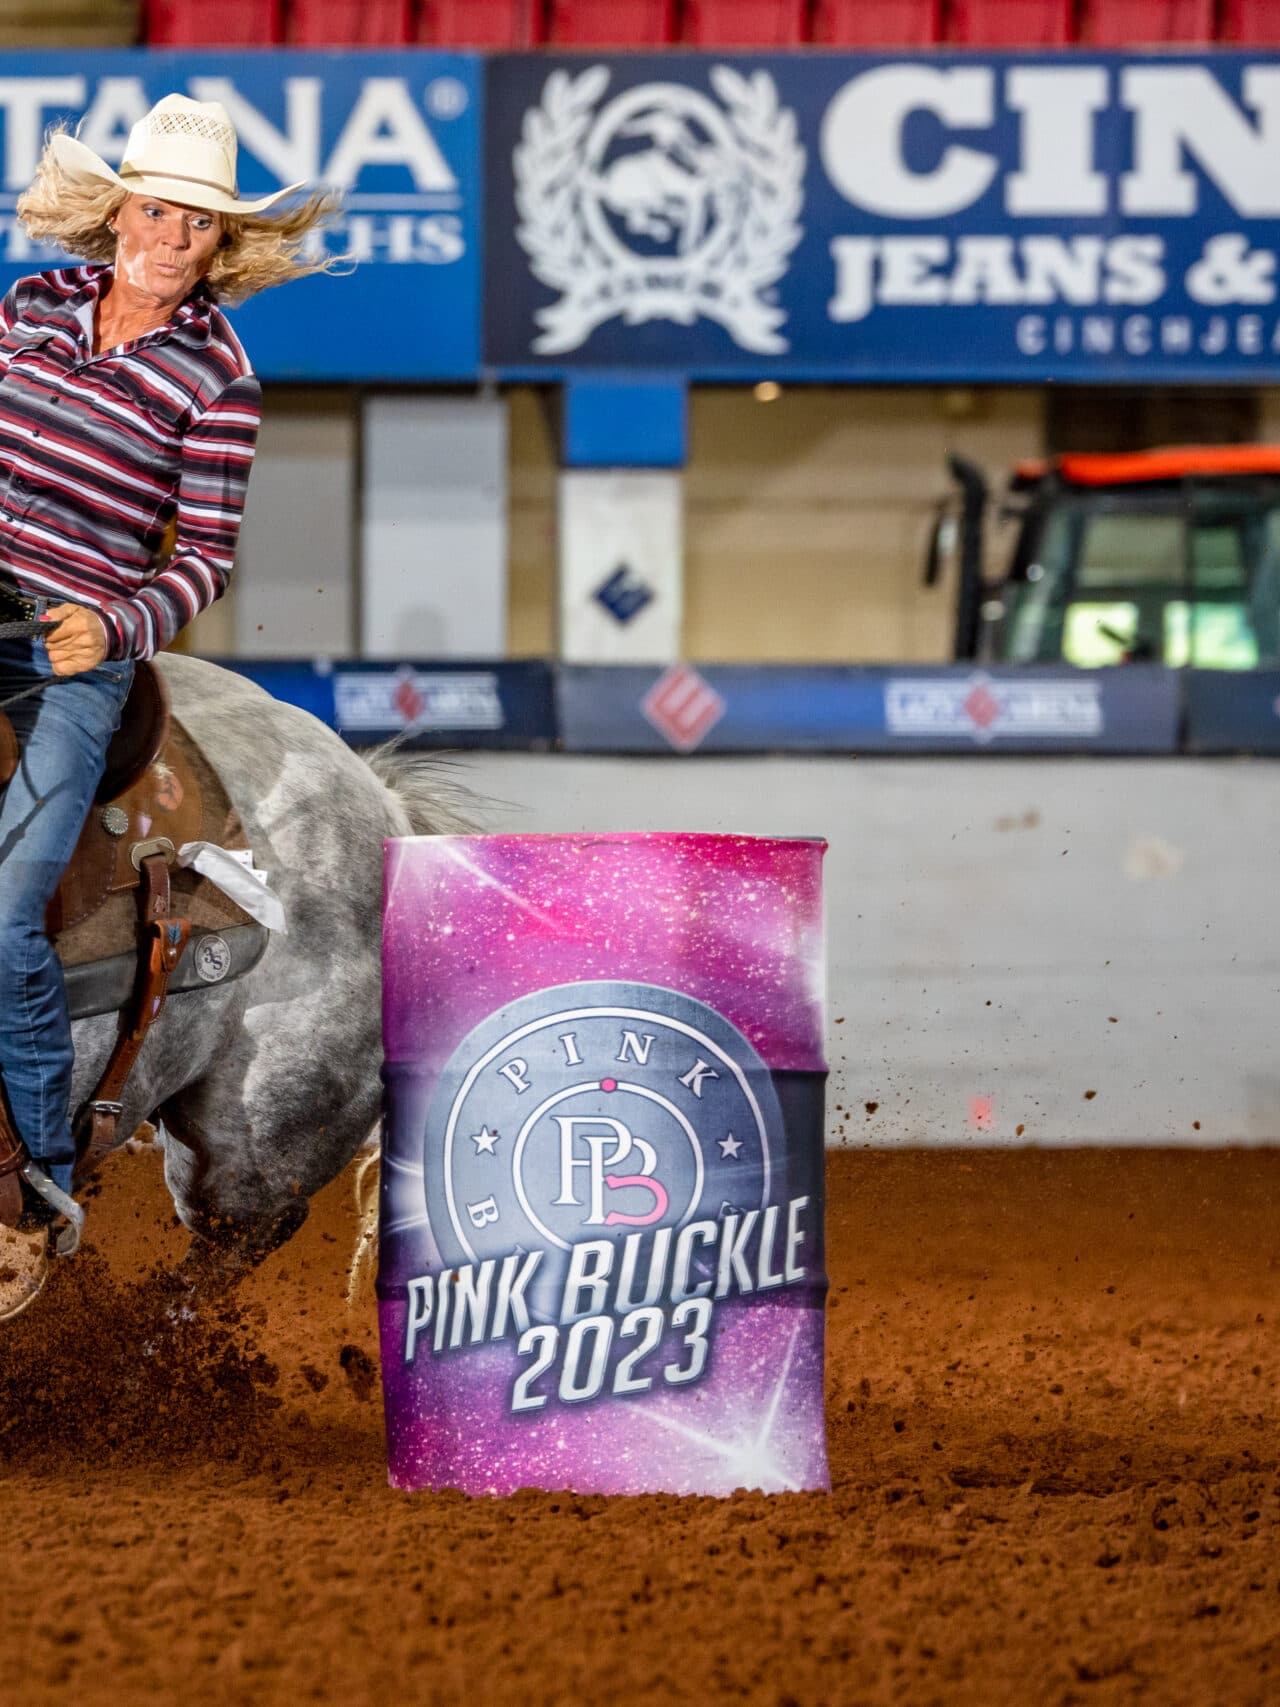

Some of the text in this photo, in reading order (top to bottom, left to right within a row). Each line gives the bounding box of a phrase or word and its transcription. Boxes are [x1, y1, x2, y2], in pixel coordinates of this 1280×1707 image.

[822, 63, 1280, 219] CIN
[828, 232, 1276, 323] JEANS &
[498, 1031, 720, 1099] PINK
[405, 1249, 545, 1362] PINK
[559, 1195, 810, 1326] BUCKLE
[511, 1298, 713, 1413] 2023
